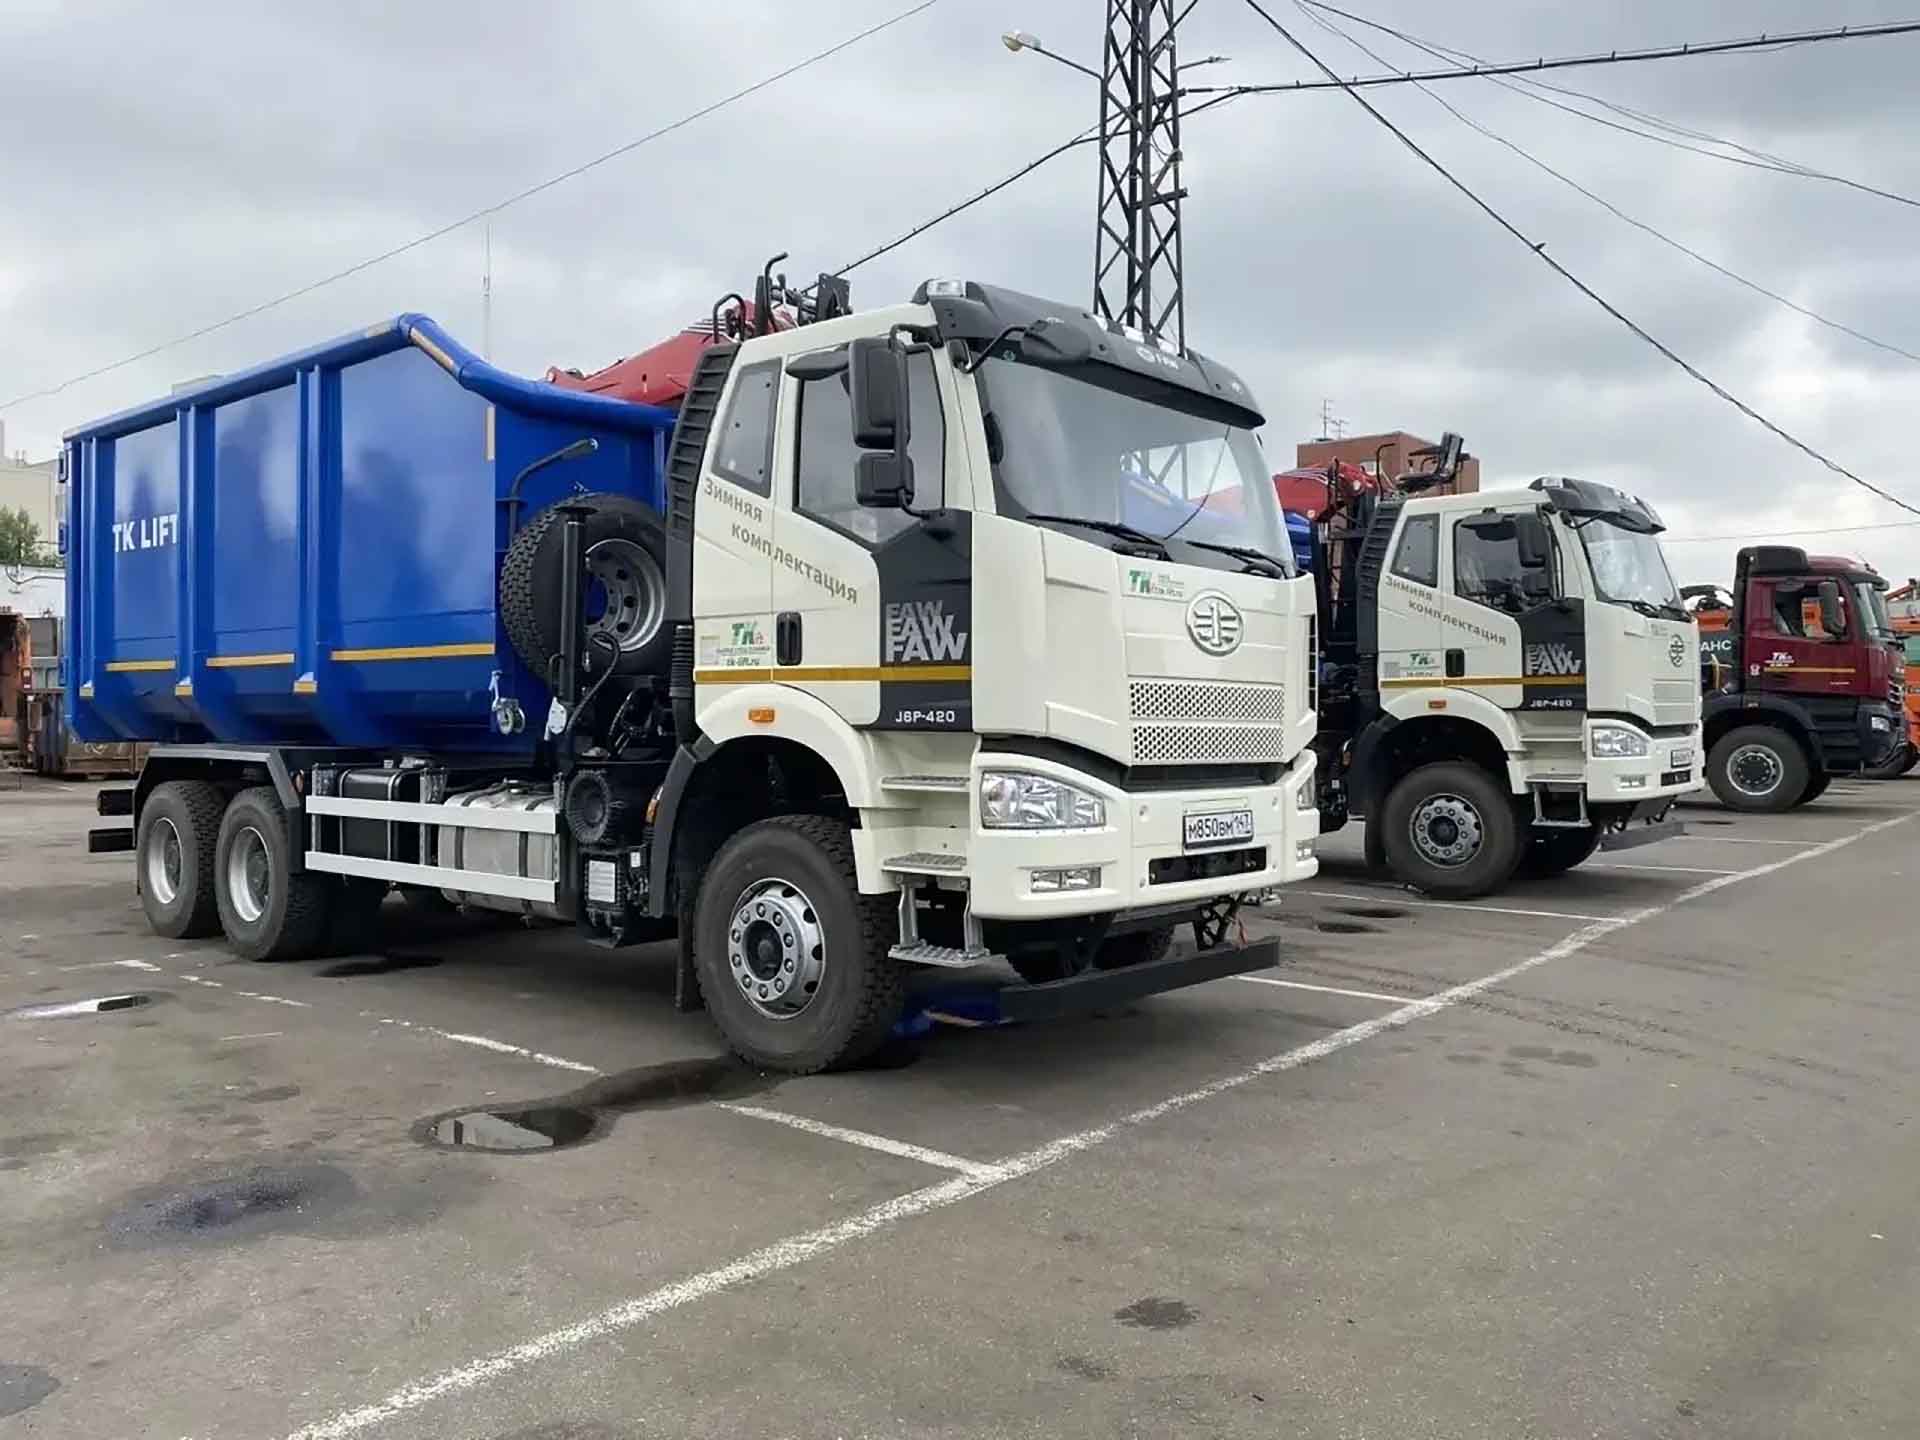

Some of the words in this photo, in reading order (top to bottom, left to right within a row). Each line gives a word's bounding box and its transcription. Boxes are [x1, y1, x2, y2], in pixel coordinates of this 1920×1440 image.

[112, 521, 136, 553] TK
[141, 514, 177, 549] LIFT
[731, 522, 858, 604] комплектация
[886, 632, 968, 662] FAW
